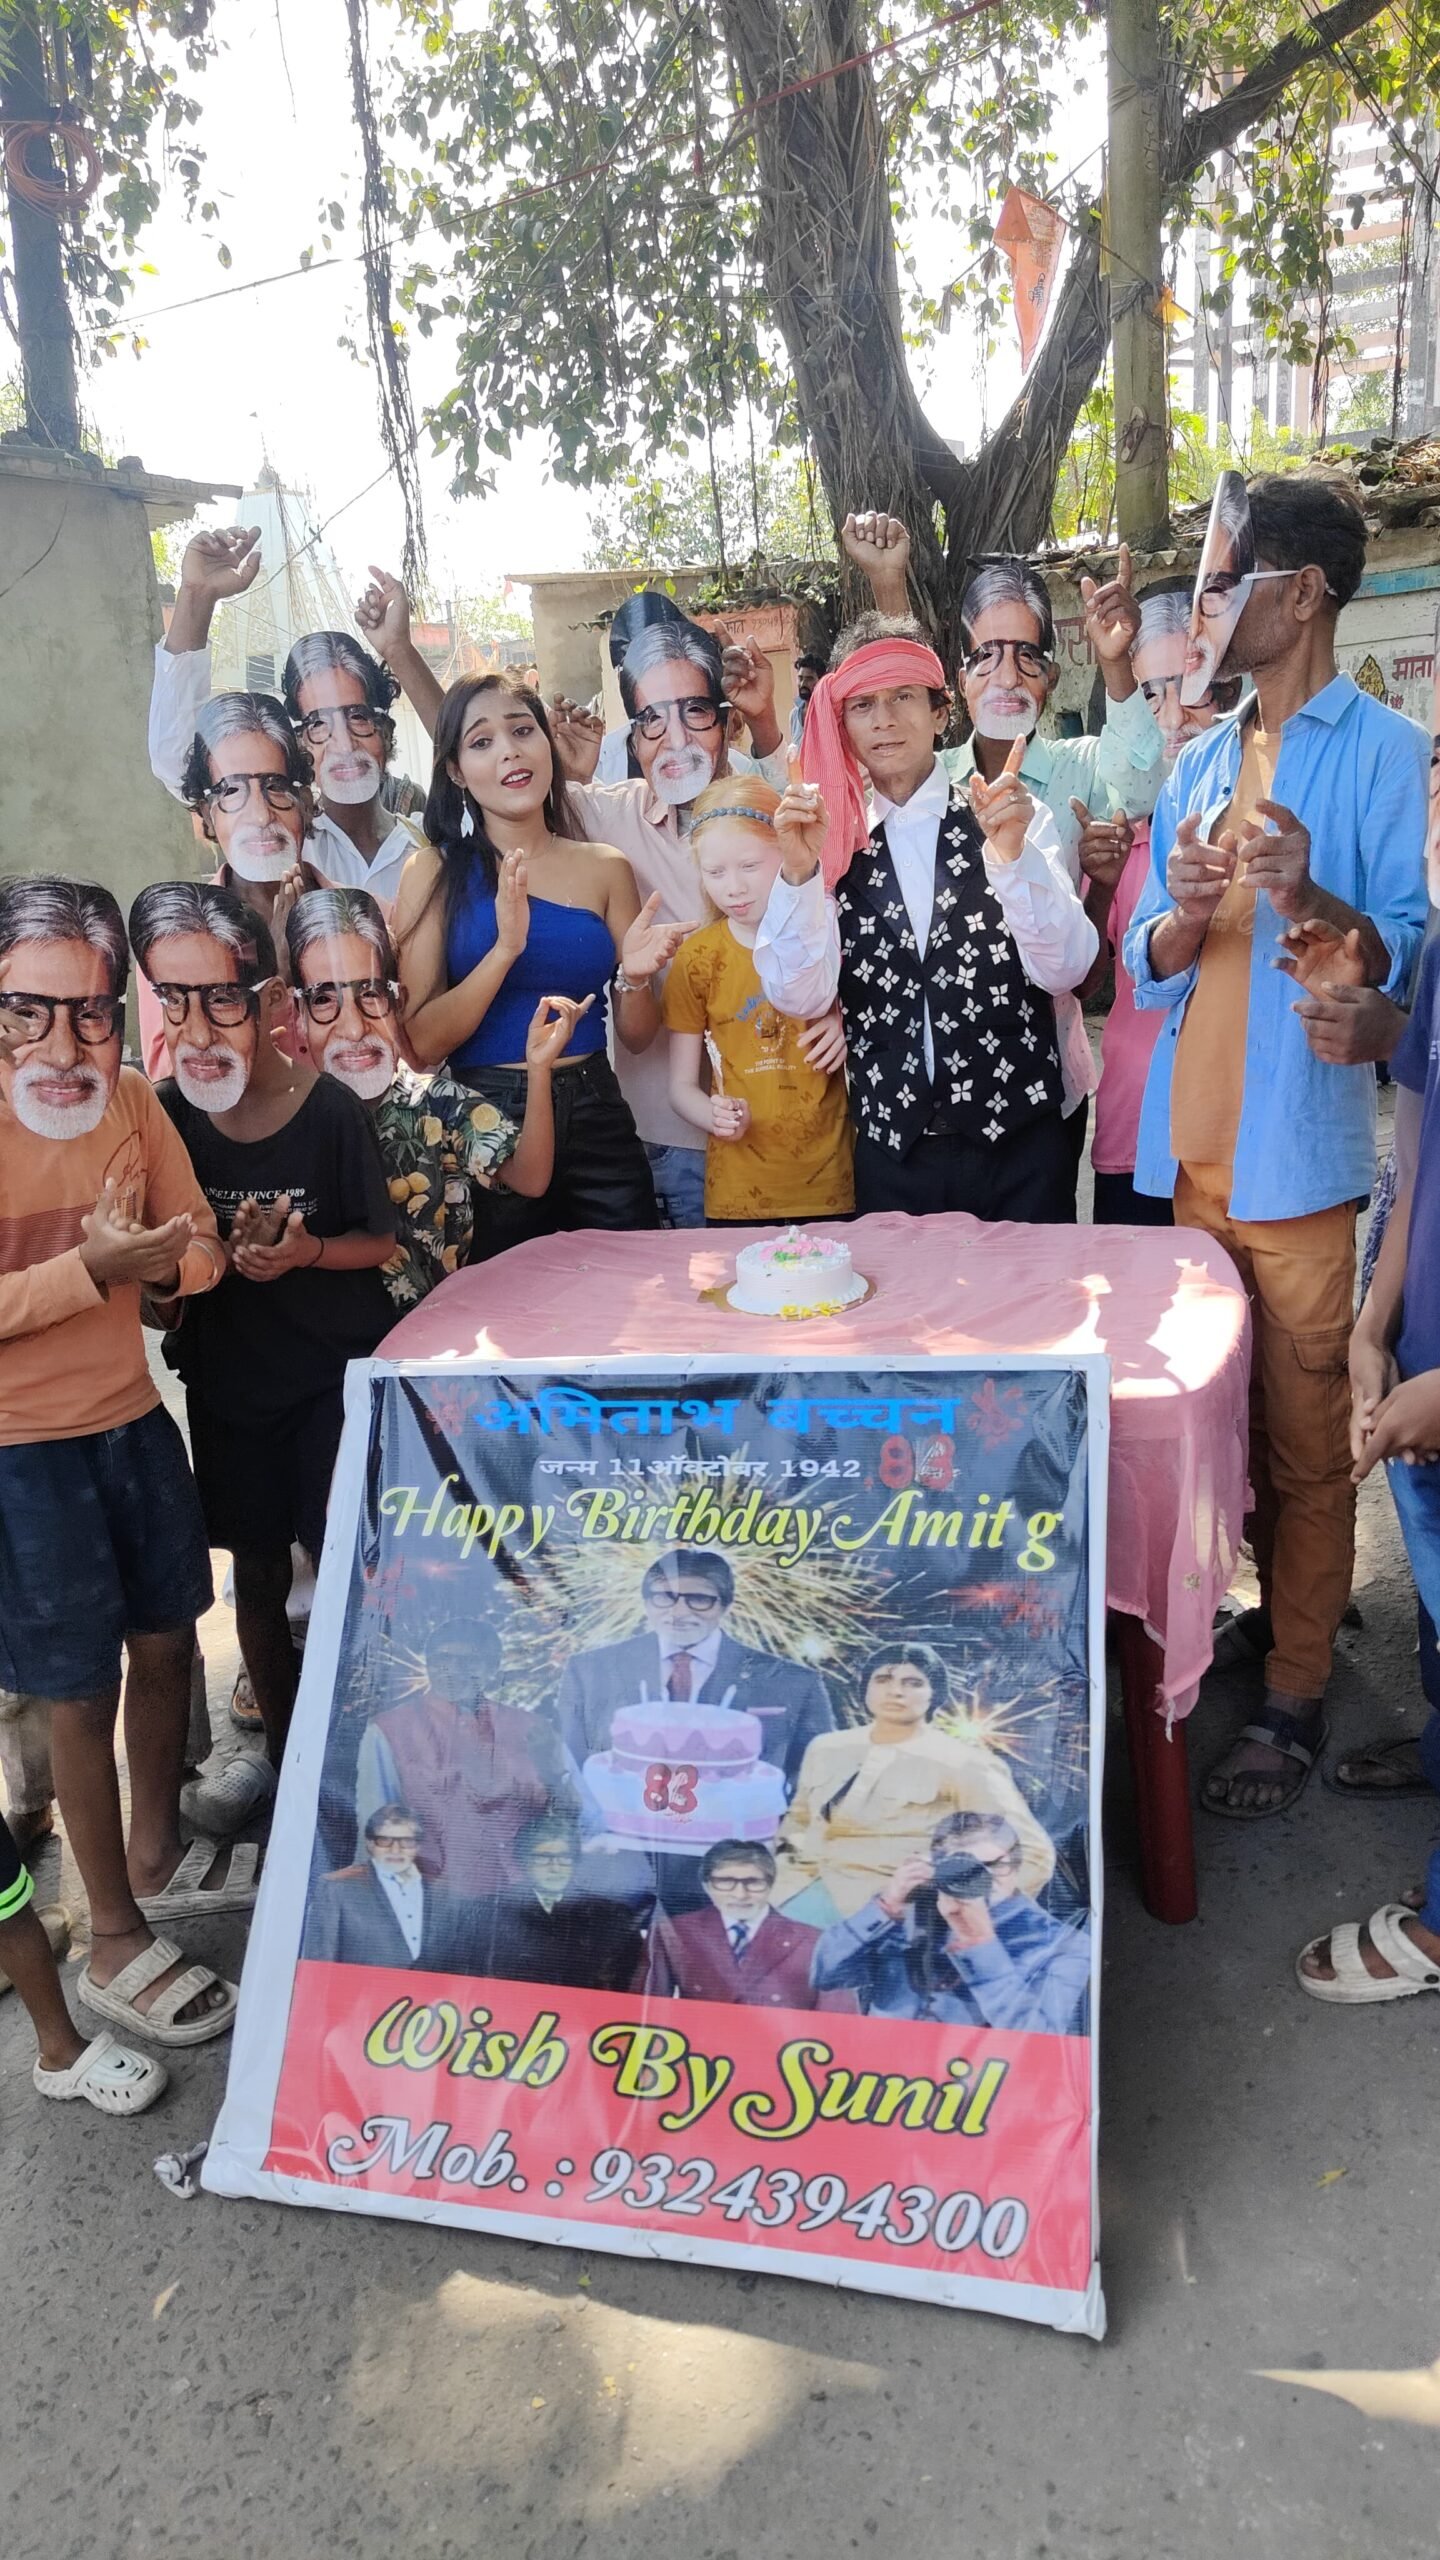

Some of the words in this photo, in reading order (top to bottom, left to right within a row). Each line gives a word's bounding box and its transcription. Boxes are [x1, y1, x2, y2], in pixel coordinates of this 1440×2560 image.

[1391, 655, 1435, 681] माता
[246, 1189, 282, 1200] SINCE
[285, 1187, 306, 1198] 1989
[474, 1386, 742, 1435] अमिताभ
[766, 1397, 962, 1435] बच्चन
[539, 1458, 599, 1477] जन्म
[780, 1458, 862, 1478] 1942
[379, 1473, 556, 1561] Happy
[565, 1484, 824, 1568] Birthday
[643, 1762, 700, 1815] 83
[363, 1996, 570, 2089] Wish
[588, 2021, 736, 2133] By
[728, 2037, 1010, 2141] Sunil
[584, 2146, 1030, 2260] 9324394300
